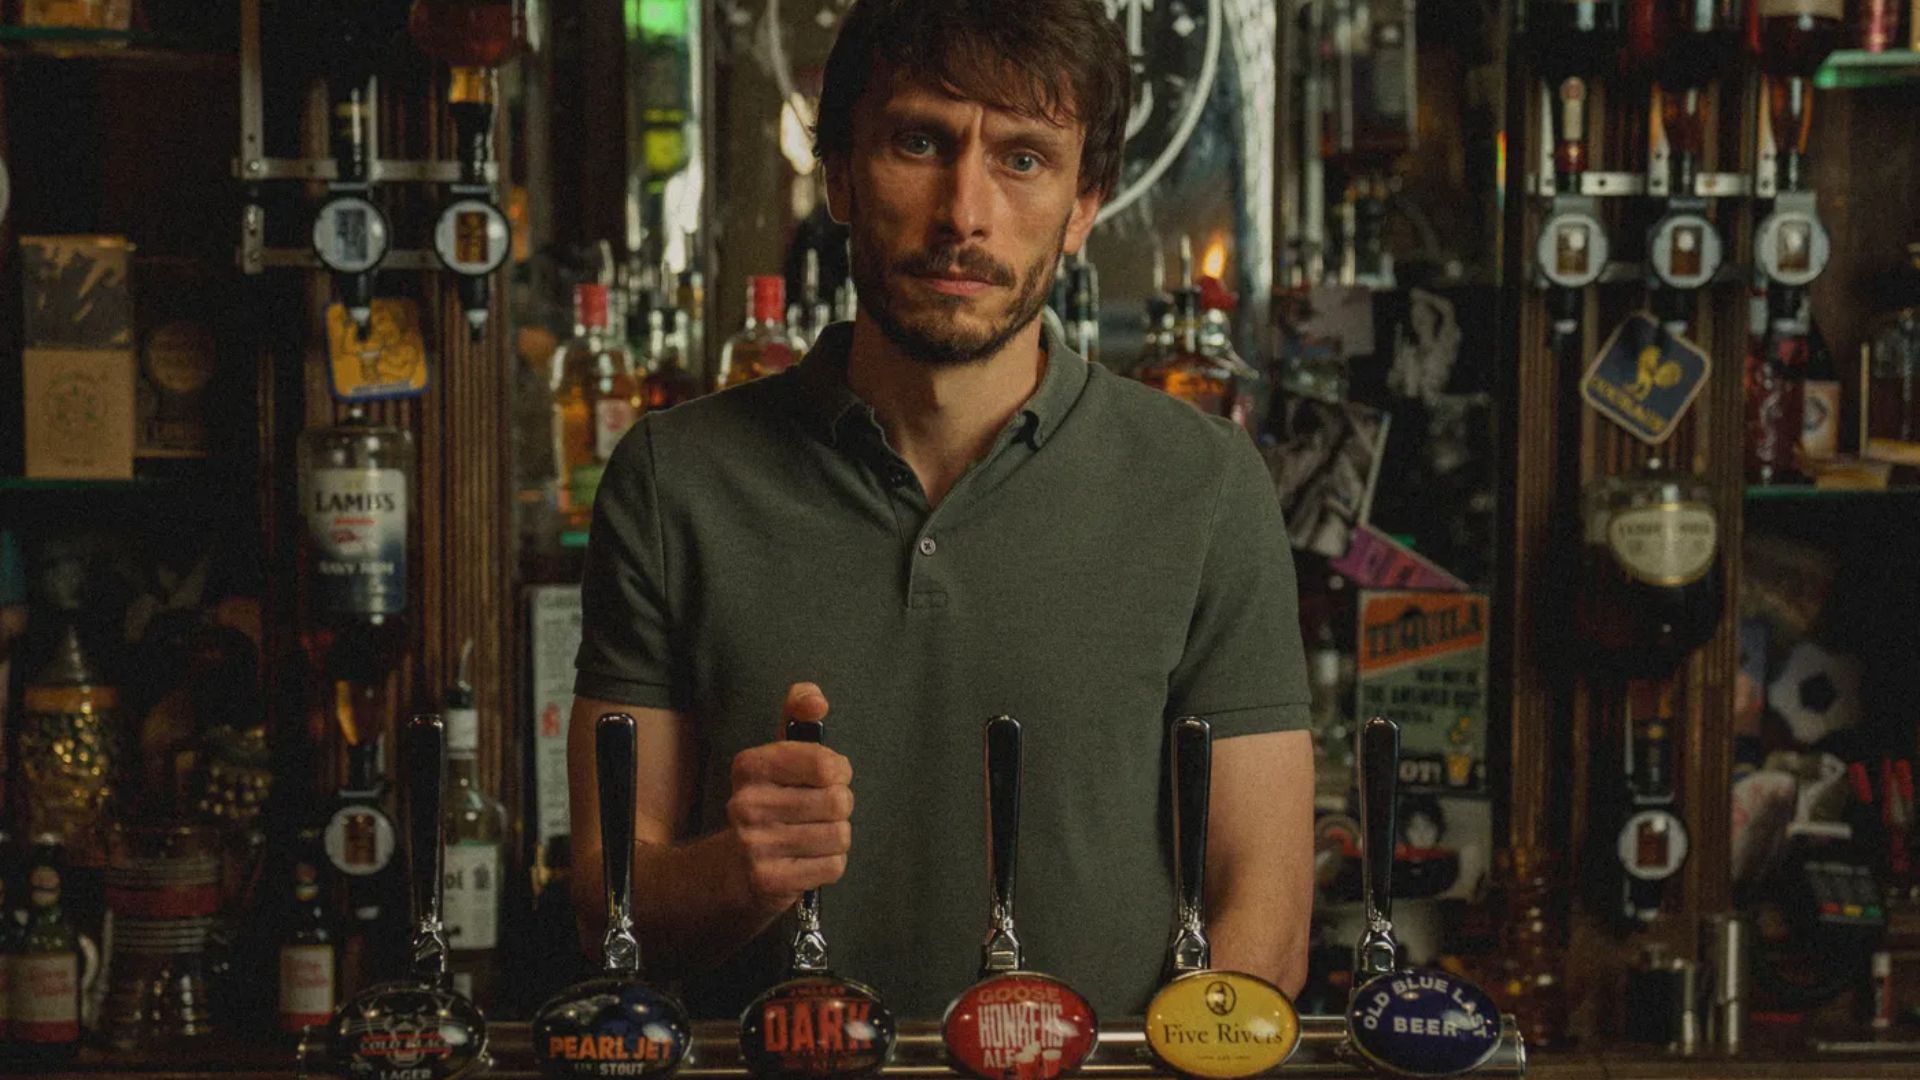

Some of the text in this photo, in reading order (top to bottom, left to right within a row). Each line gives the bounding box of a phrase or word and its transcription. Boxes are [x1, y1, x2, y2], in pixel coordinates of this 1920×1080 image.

[1368, 603, 1481, 659] TEQUILA
[1400, 758, 1441, 781] OT!
[976, 987, 1061, 1002] GOOSE
[1363, 991, 1390, 1031] OLD
[1391, 976, 1449, 994] BLUE
[763, 1001, 871, 1051] DARK
[977, 1001, 1064, 1049] HONKERS
[1163, 1023, 1282, 1044] Five Rivers
[1393, 1016, 1457, 1037] BEER
[548, 1036, 674, 1061] PEARL JET
[380, 1069, 432, 1080] LAGER
[599, 1063, 645, 1077] STOUT
